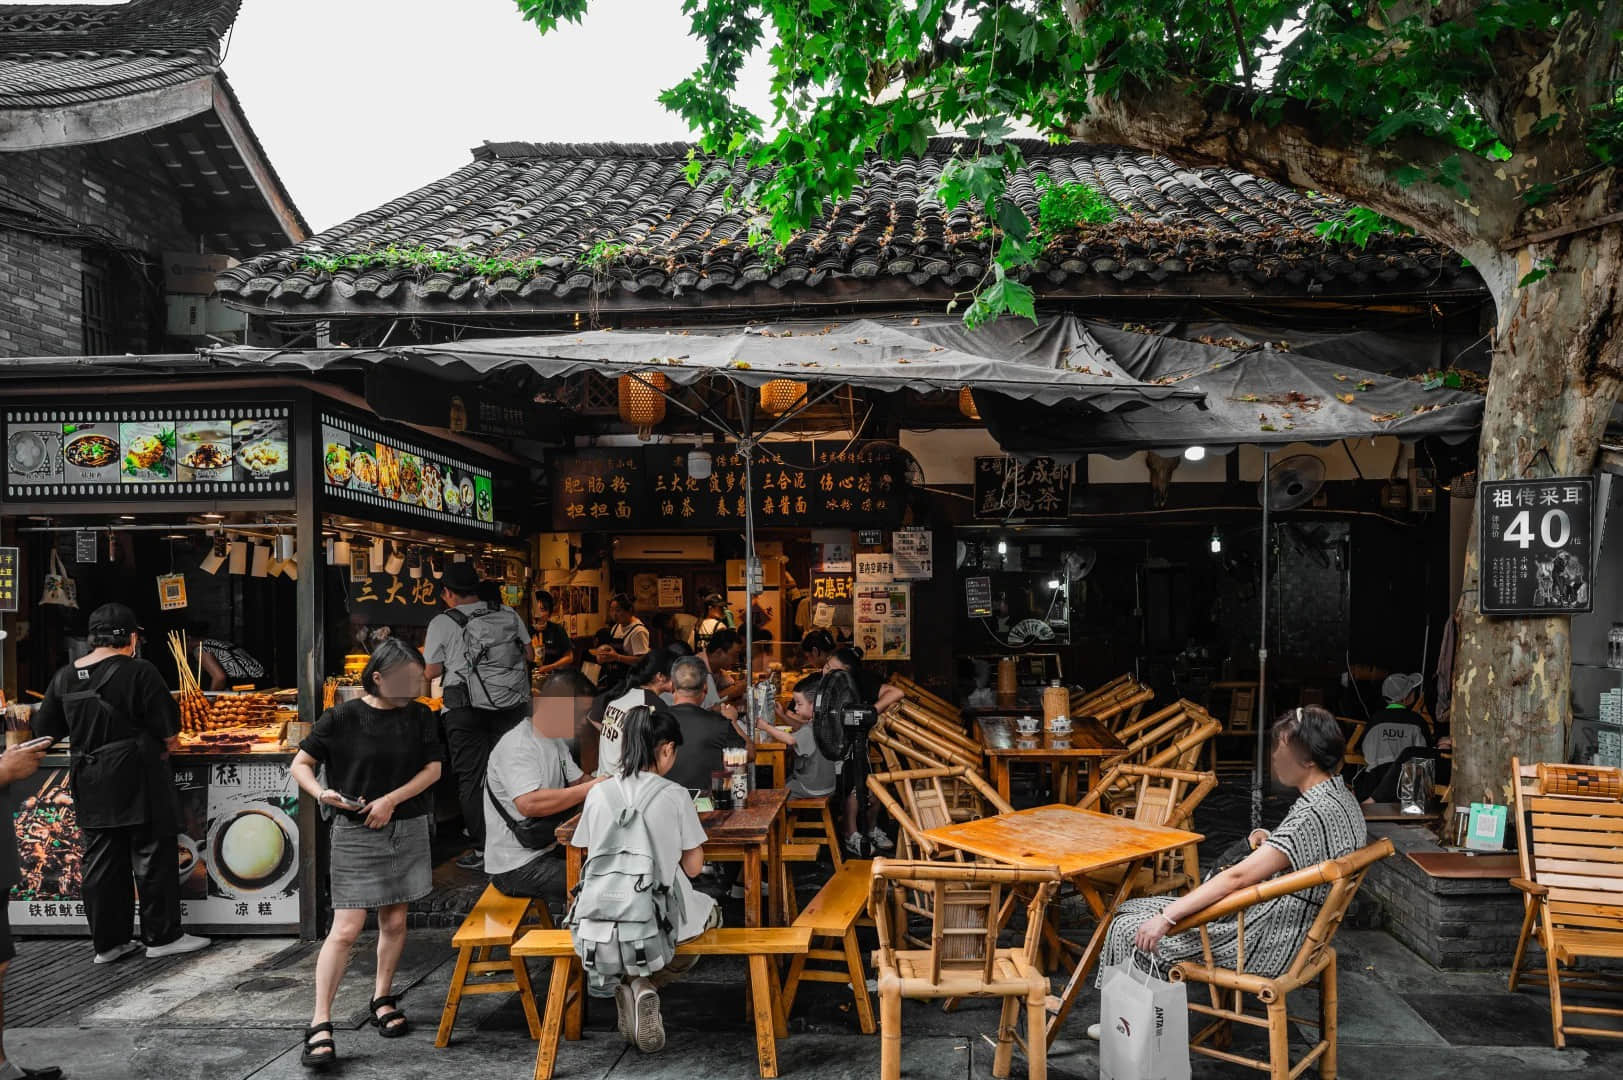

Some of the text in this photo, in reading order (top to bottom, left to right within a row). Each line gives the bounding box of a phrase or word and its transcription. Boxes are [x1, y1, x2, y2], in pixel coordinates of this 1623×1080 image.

[563, 474, 631, 494] 肥肠粉
[655, 472, 700, 493] 三大炮
[762, 469, 808, 491] 三合泥
[565, 498, 632, 520] 担担面
[661, 496, 695, 518] 油茶
[1492, 486, 1583, 508] 祖传采耳
[1503, 508, 1571, 549] 40
[355, 576, 437, 606] 三大炮
[28, 903, 87, 917] 铁板鱿鱼
[235, 902, 273, 916] 凉糕
[1154, 1006, 1164, 1029] ANTA
